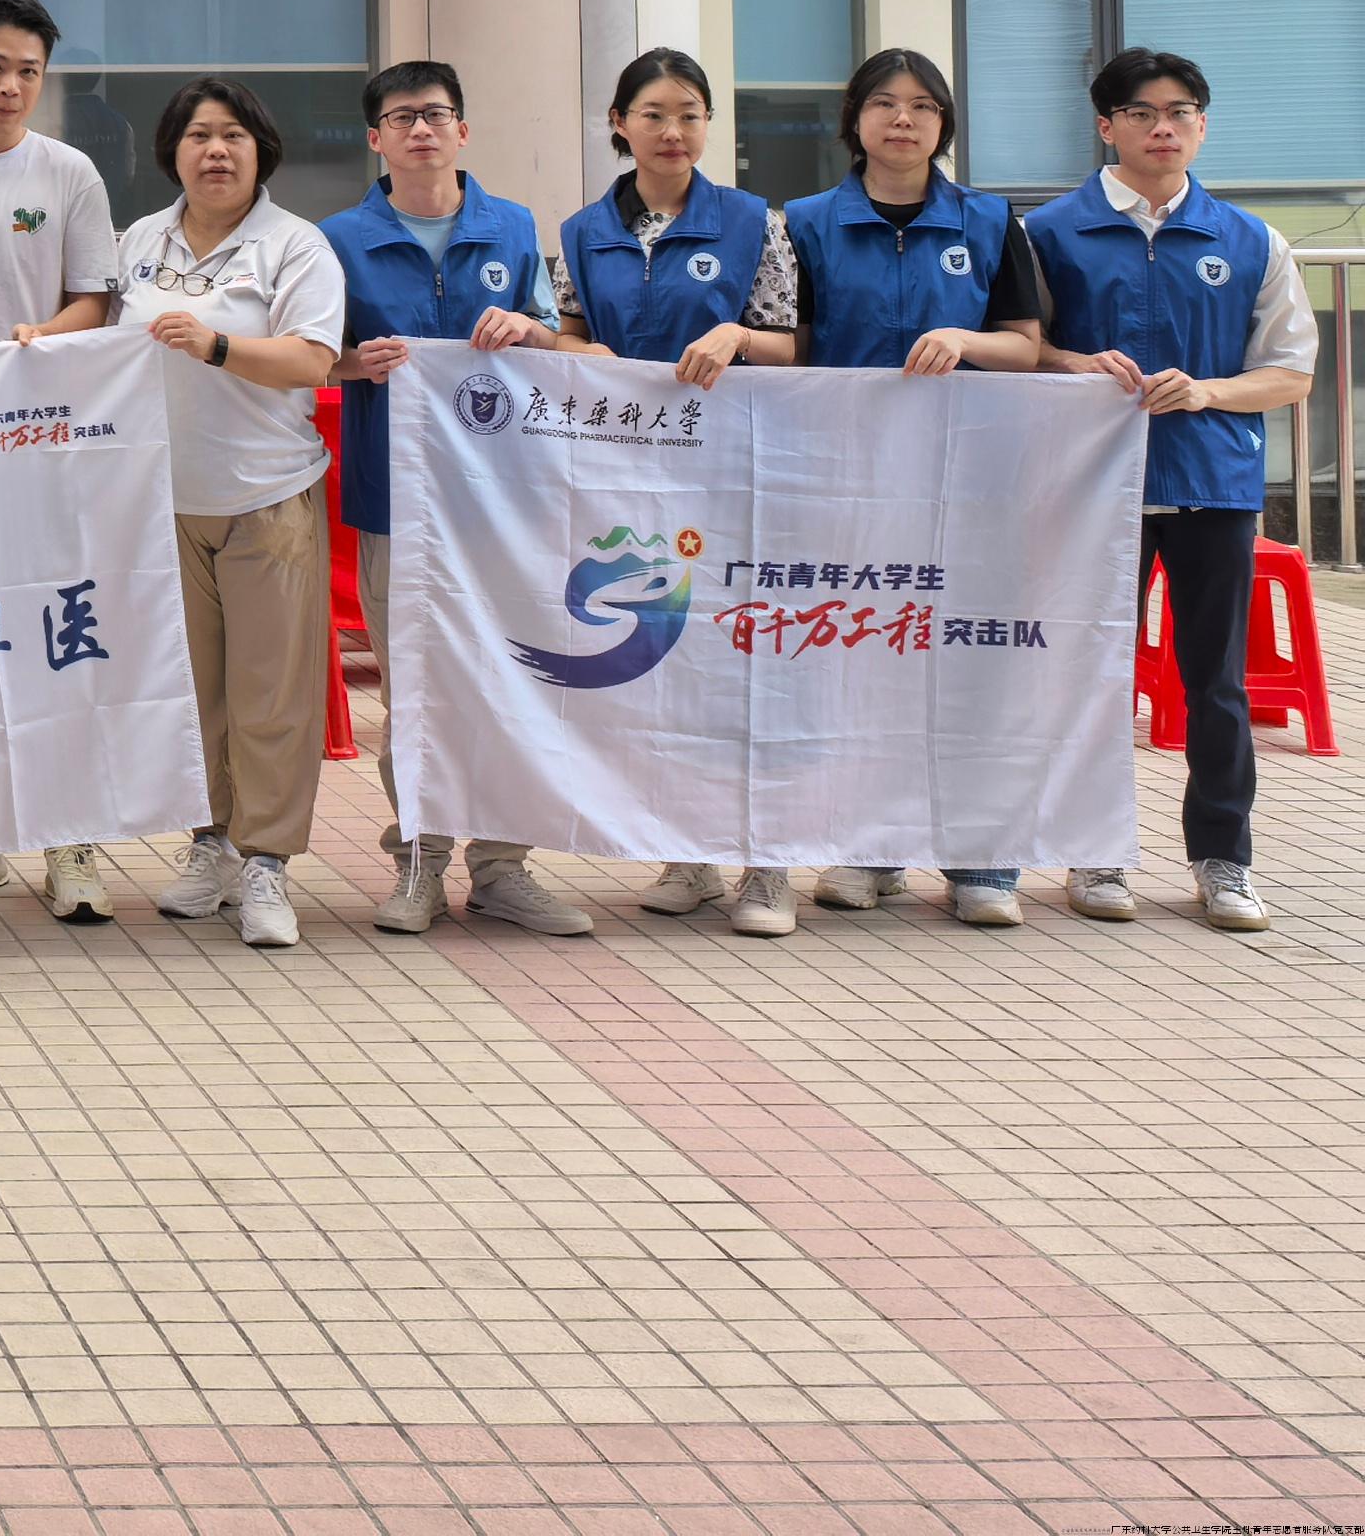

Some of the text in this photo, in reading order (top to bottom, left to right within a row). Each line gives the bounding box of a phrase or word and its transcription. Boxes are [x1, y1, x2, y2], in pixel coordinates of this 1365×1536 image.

[73, 422, 117, 440] 突击队
[521, 425, 705, 448] GUANGDONG PHARMACEUTICAL UNIVERSITY
[724, 560, 946, 591] 广东青年大学生
[713, 599, 1049, 660] 百千万工程 突击队
